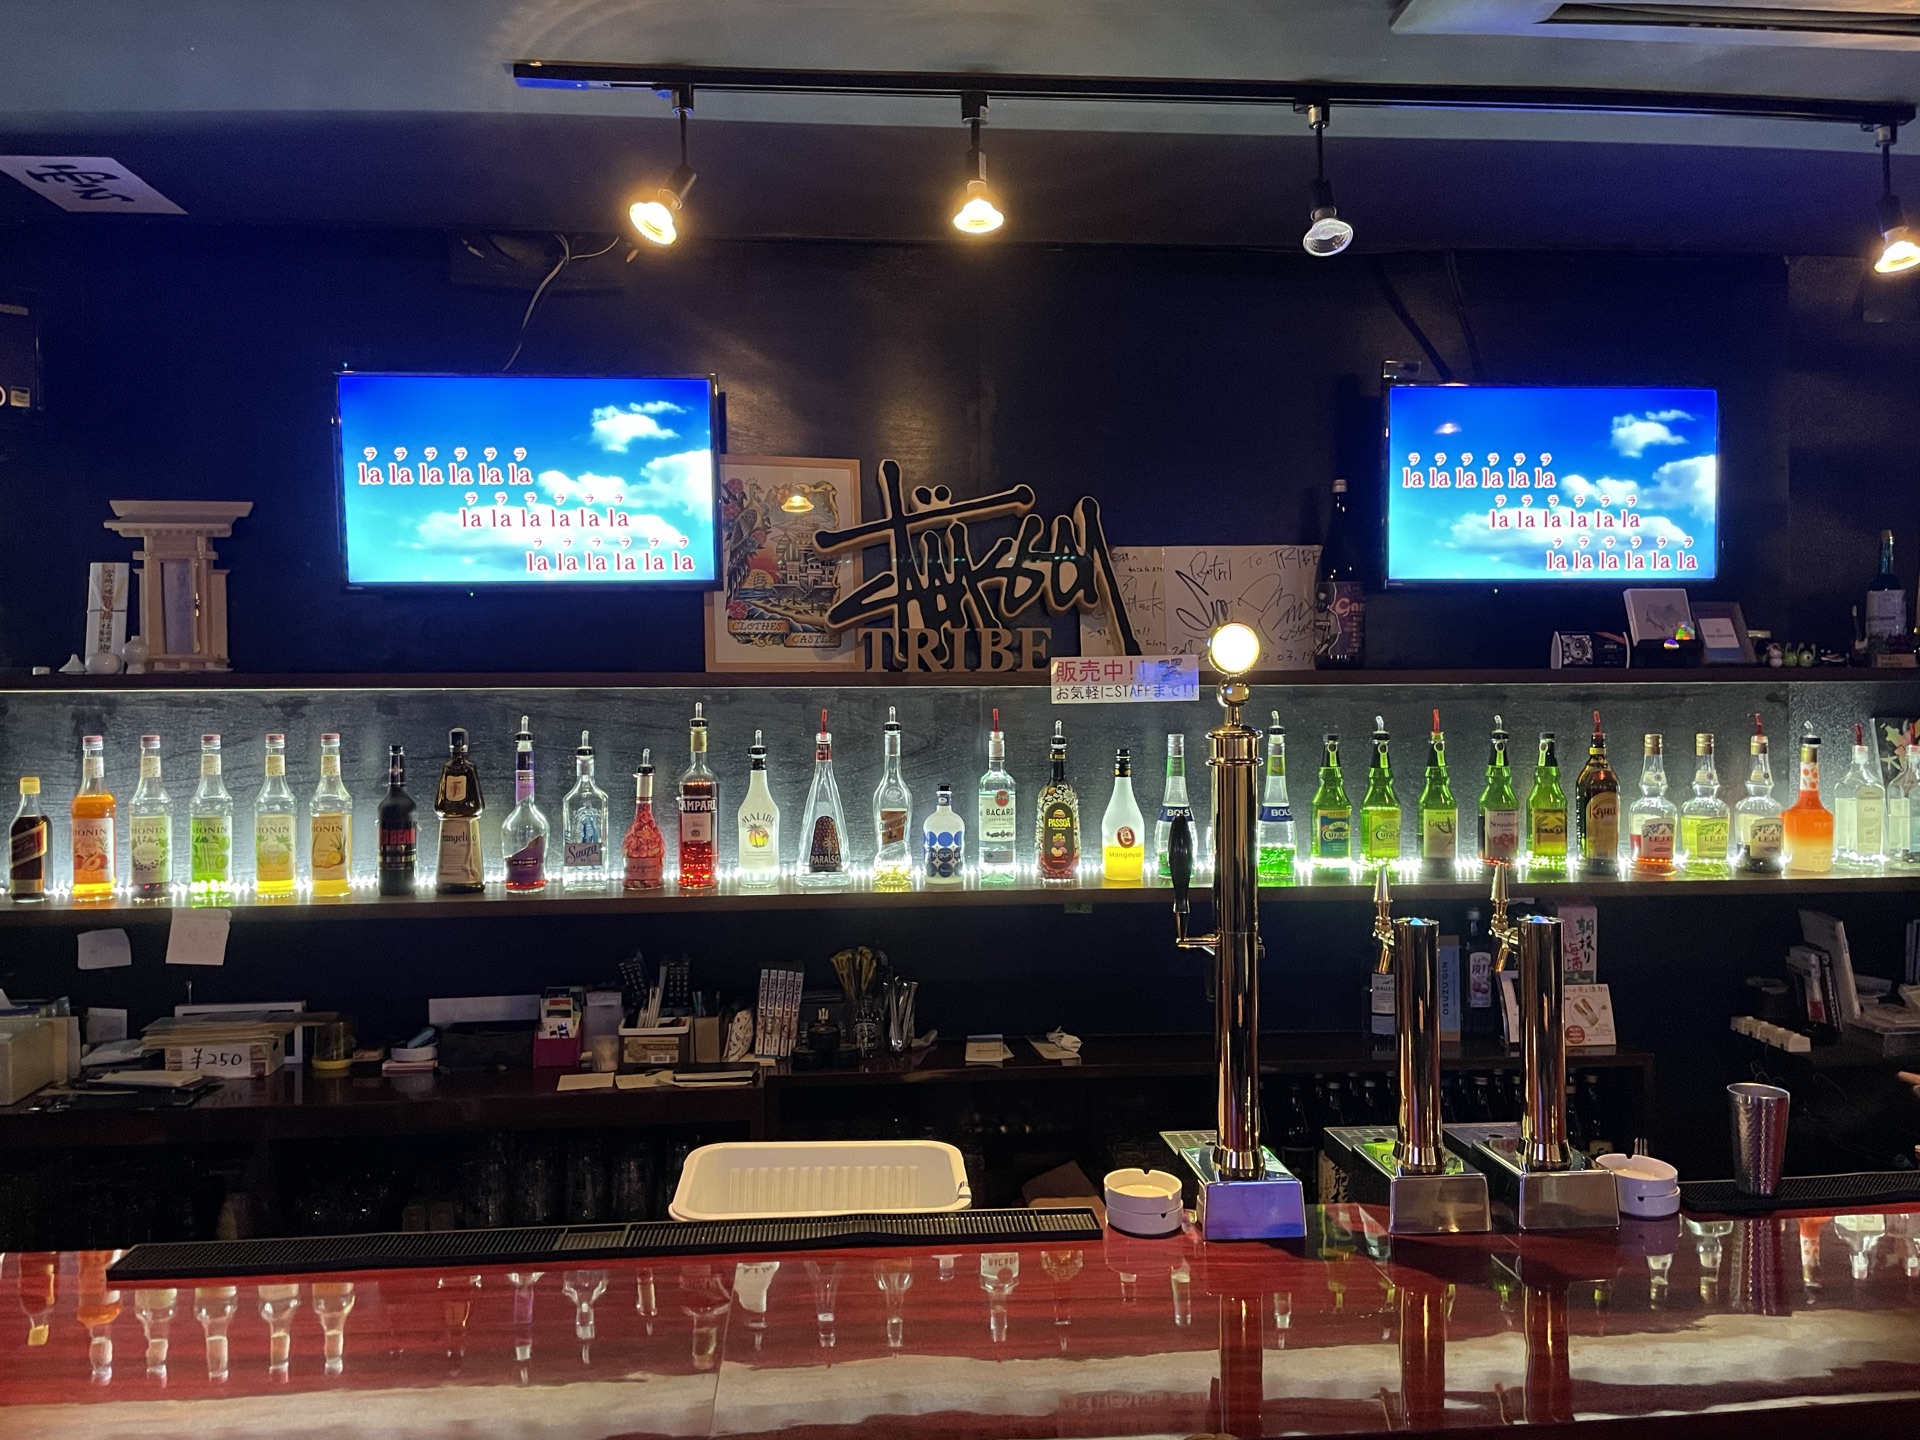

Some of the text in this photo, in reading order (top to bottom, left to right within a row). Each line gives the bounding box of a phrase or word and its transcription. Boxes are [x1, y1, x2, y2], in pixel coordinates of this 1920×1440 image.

[365, 448, 525, 459] ラ ラ ラ ラ ラ ラ
[1409, 453, 1551, 464] ラ ラ ラ ラ ラ ラ
[360, 464, 531, 484] la la la la la la
[1404, 468, 1554, 487] la la la la la la
[466, 493, 624, 504] ラ ラ ラ ラ ラ ラ
[1496, 495, 1636, 506] ラ ラ ラ ラ ラ ラ
[461, 509, 629, 528] la la la la la la
[1491, 510, 1640, 528] la la la la la la
[533, 537, 688, 547] ラ ラ ラ ラ ラ ラ
[1553, 537, 1694, 548] ラ ラ ラ ラ ラ ラ
[528, 552, 694, 571] la la la la la la
[1548, 551, 1696, 569] la la la la la la
[857, 627, 1052, 673] TRIBE
[678, 798, 717, 811] CAMPARI
